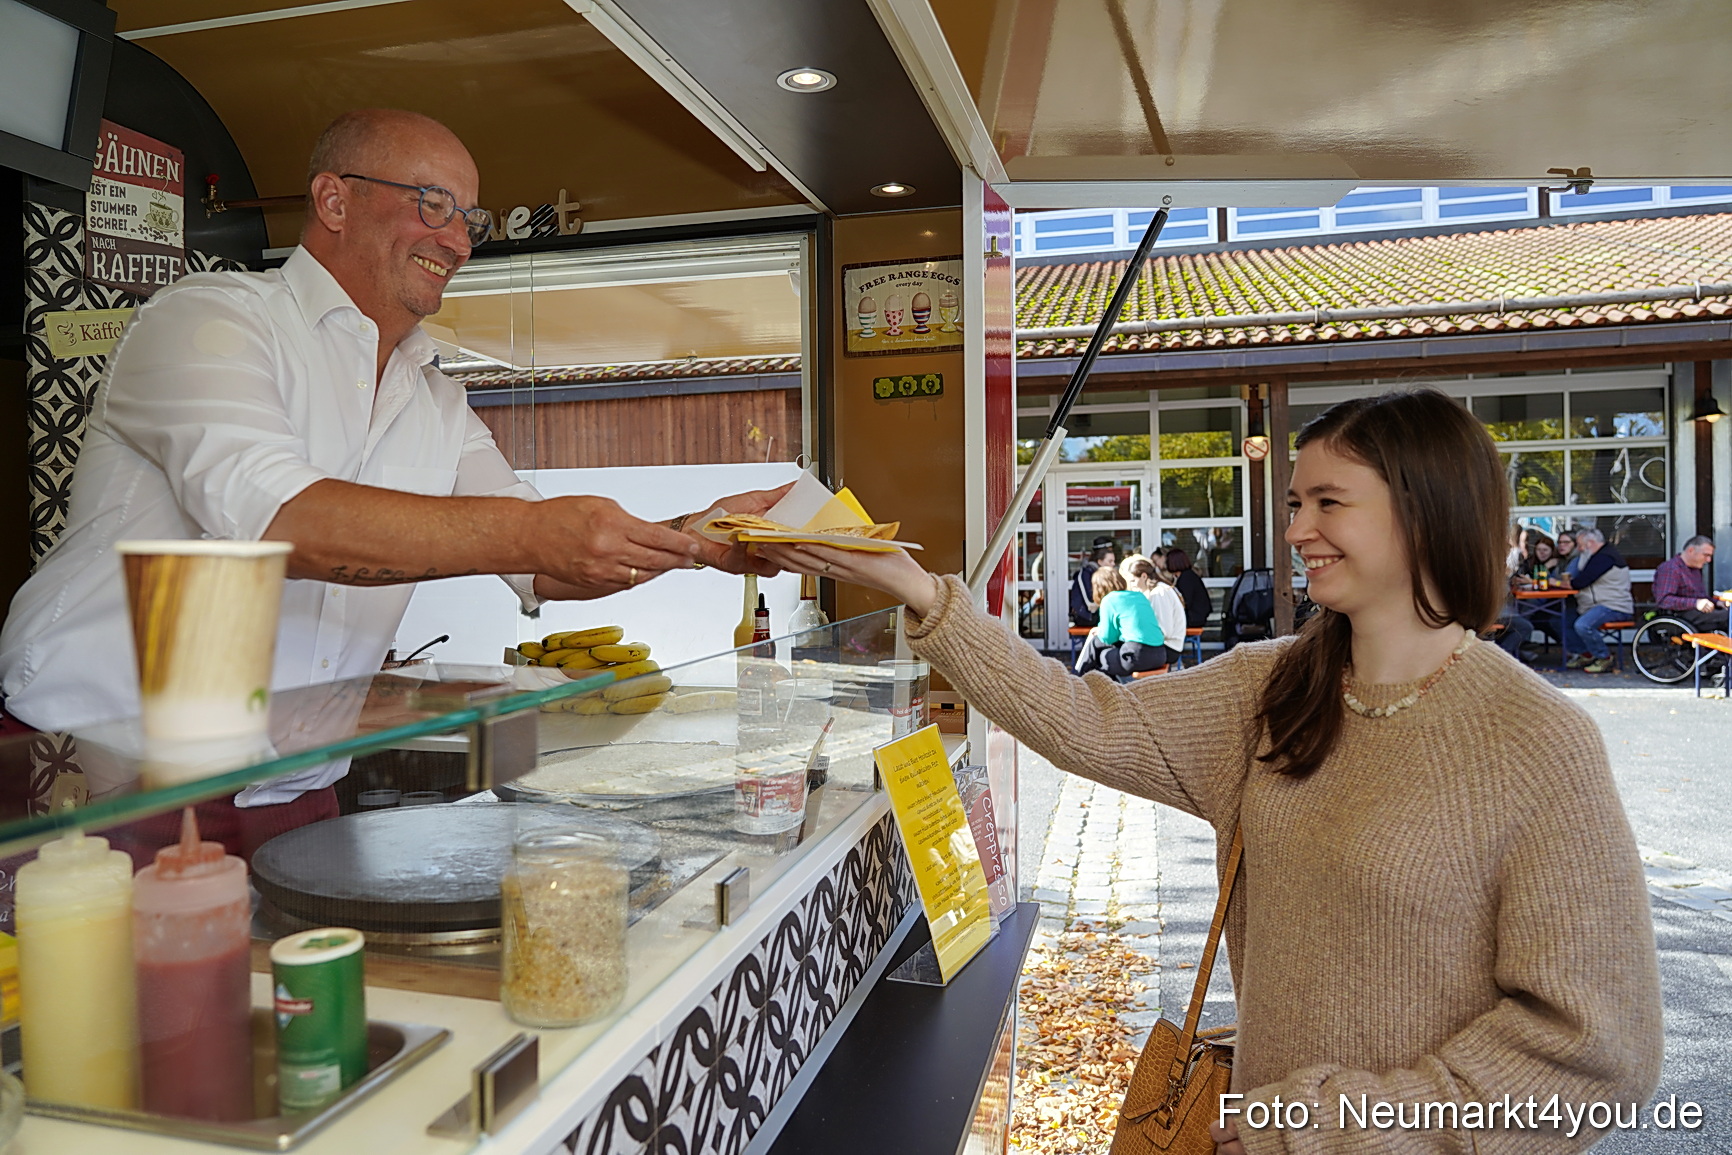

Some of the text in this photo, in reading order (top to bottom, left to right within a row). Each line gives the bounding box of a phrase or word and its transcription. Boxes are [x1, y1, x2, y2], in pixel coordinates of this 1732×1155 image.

[91, 183, 126, 199] IST EIN
[90, 200, 138, 217] STUMMER
[90, 216, 128, 231] SCHREI
[91, 236, 117, 250] NACH
[92, 251, 181, 285] KAFFEE
[858, 270, 961, 294] FREE RANGE EGGS
[982, 797, 1007, 906] Creppresso
